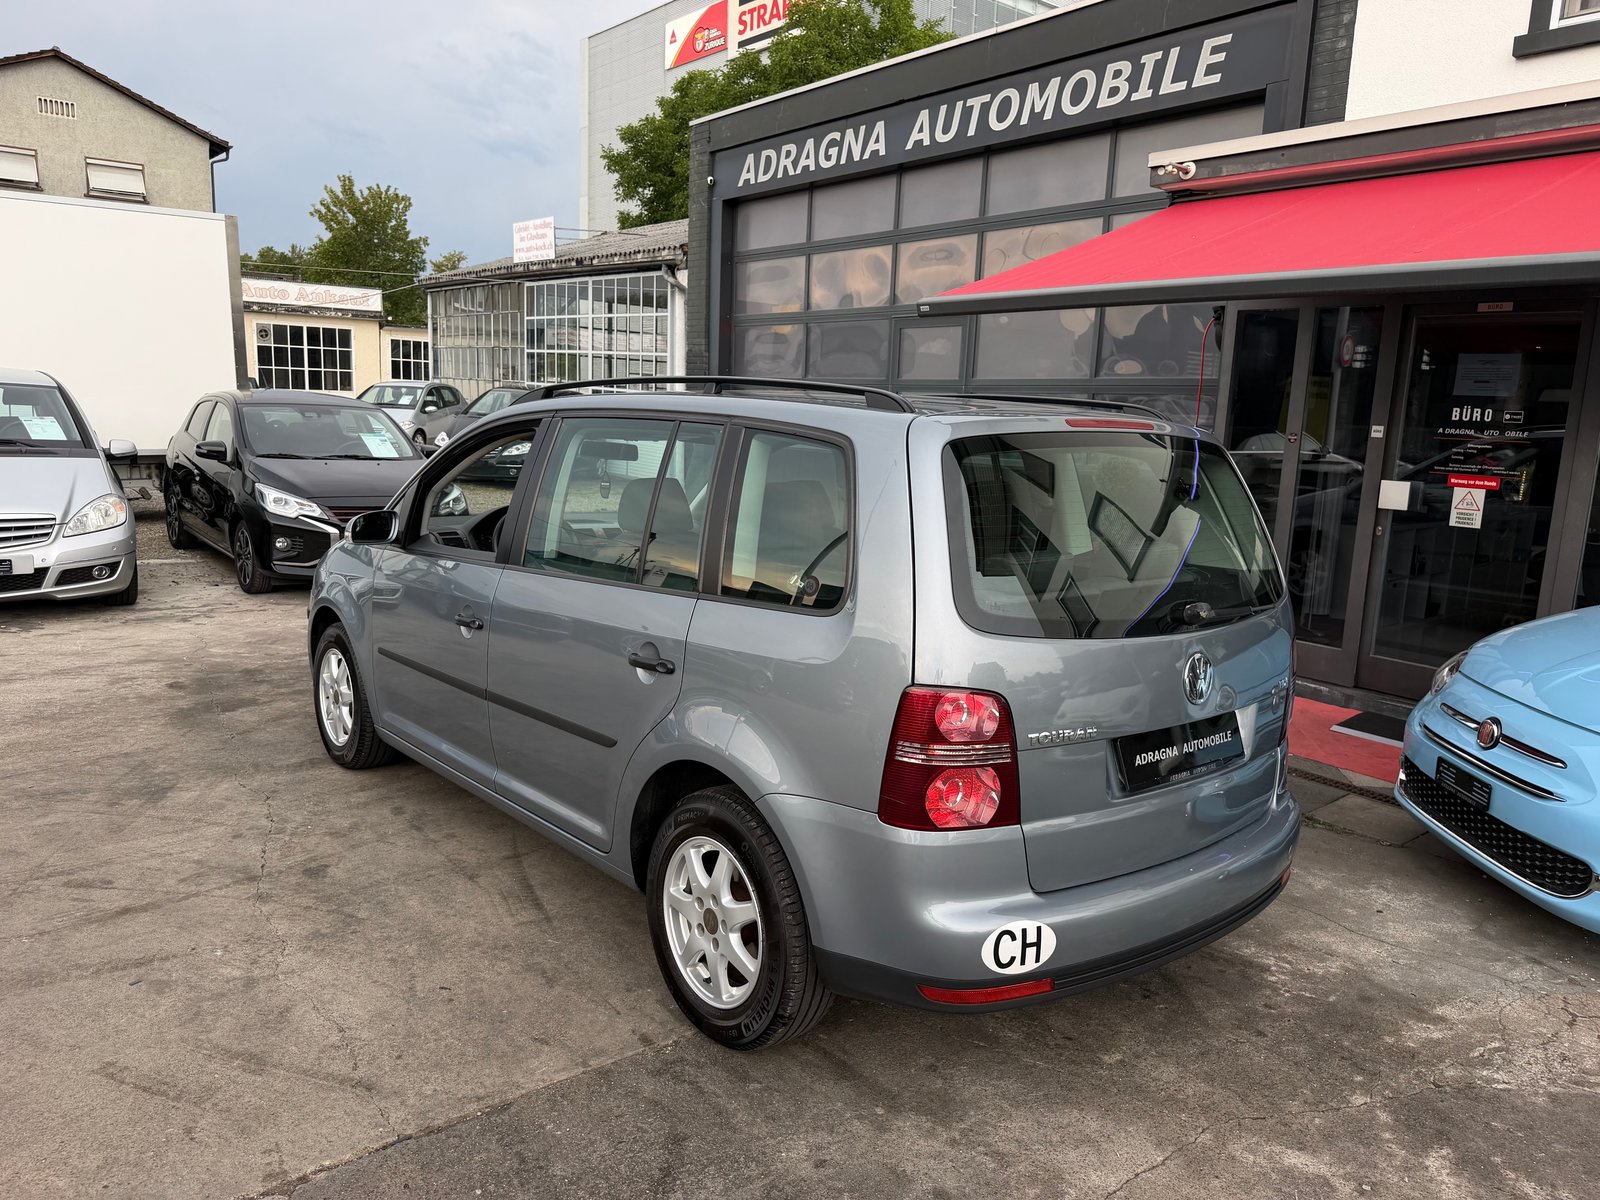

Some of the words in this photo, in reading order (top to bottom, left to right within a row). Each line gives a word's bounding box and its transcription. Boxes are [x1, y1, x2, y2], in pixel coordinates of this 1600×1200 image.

[737, 120, 886, 187] ADRAGNA
[905, 34, 1233, 150] AUTOMOBILE
[242, 281, 289, 300] Auto
[295, 287, 370, 306] Ankauf
[1452, 406, 1493, 422] BÜRO
[1027, 725, 1098, 747] TOURAN
[1135, 745, 1178, 767] ADRAGNA
[1183, 730, 1232, 754] AUTOMOBILE
[993, 925, 1041, 969] CH
